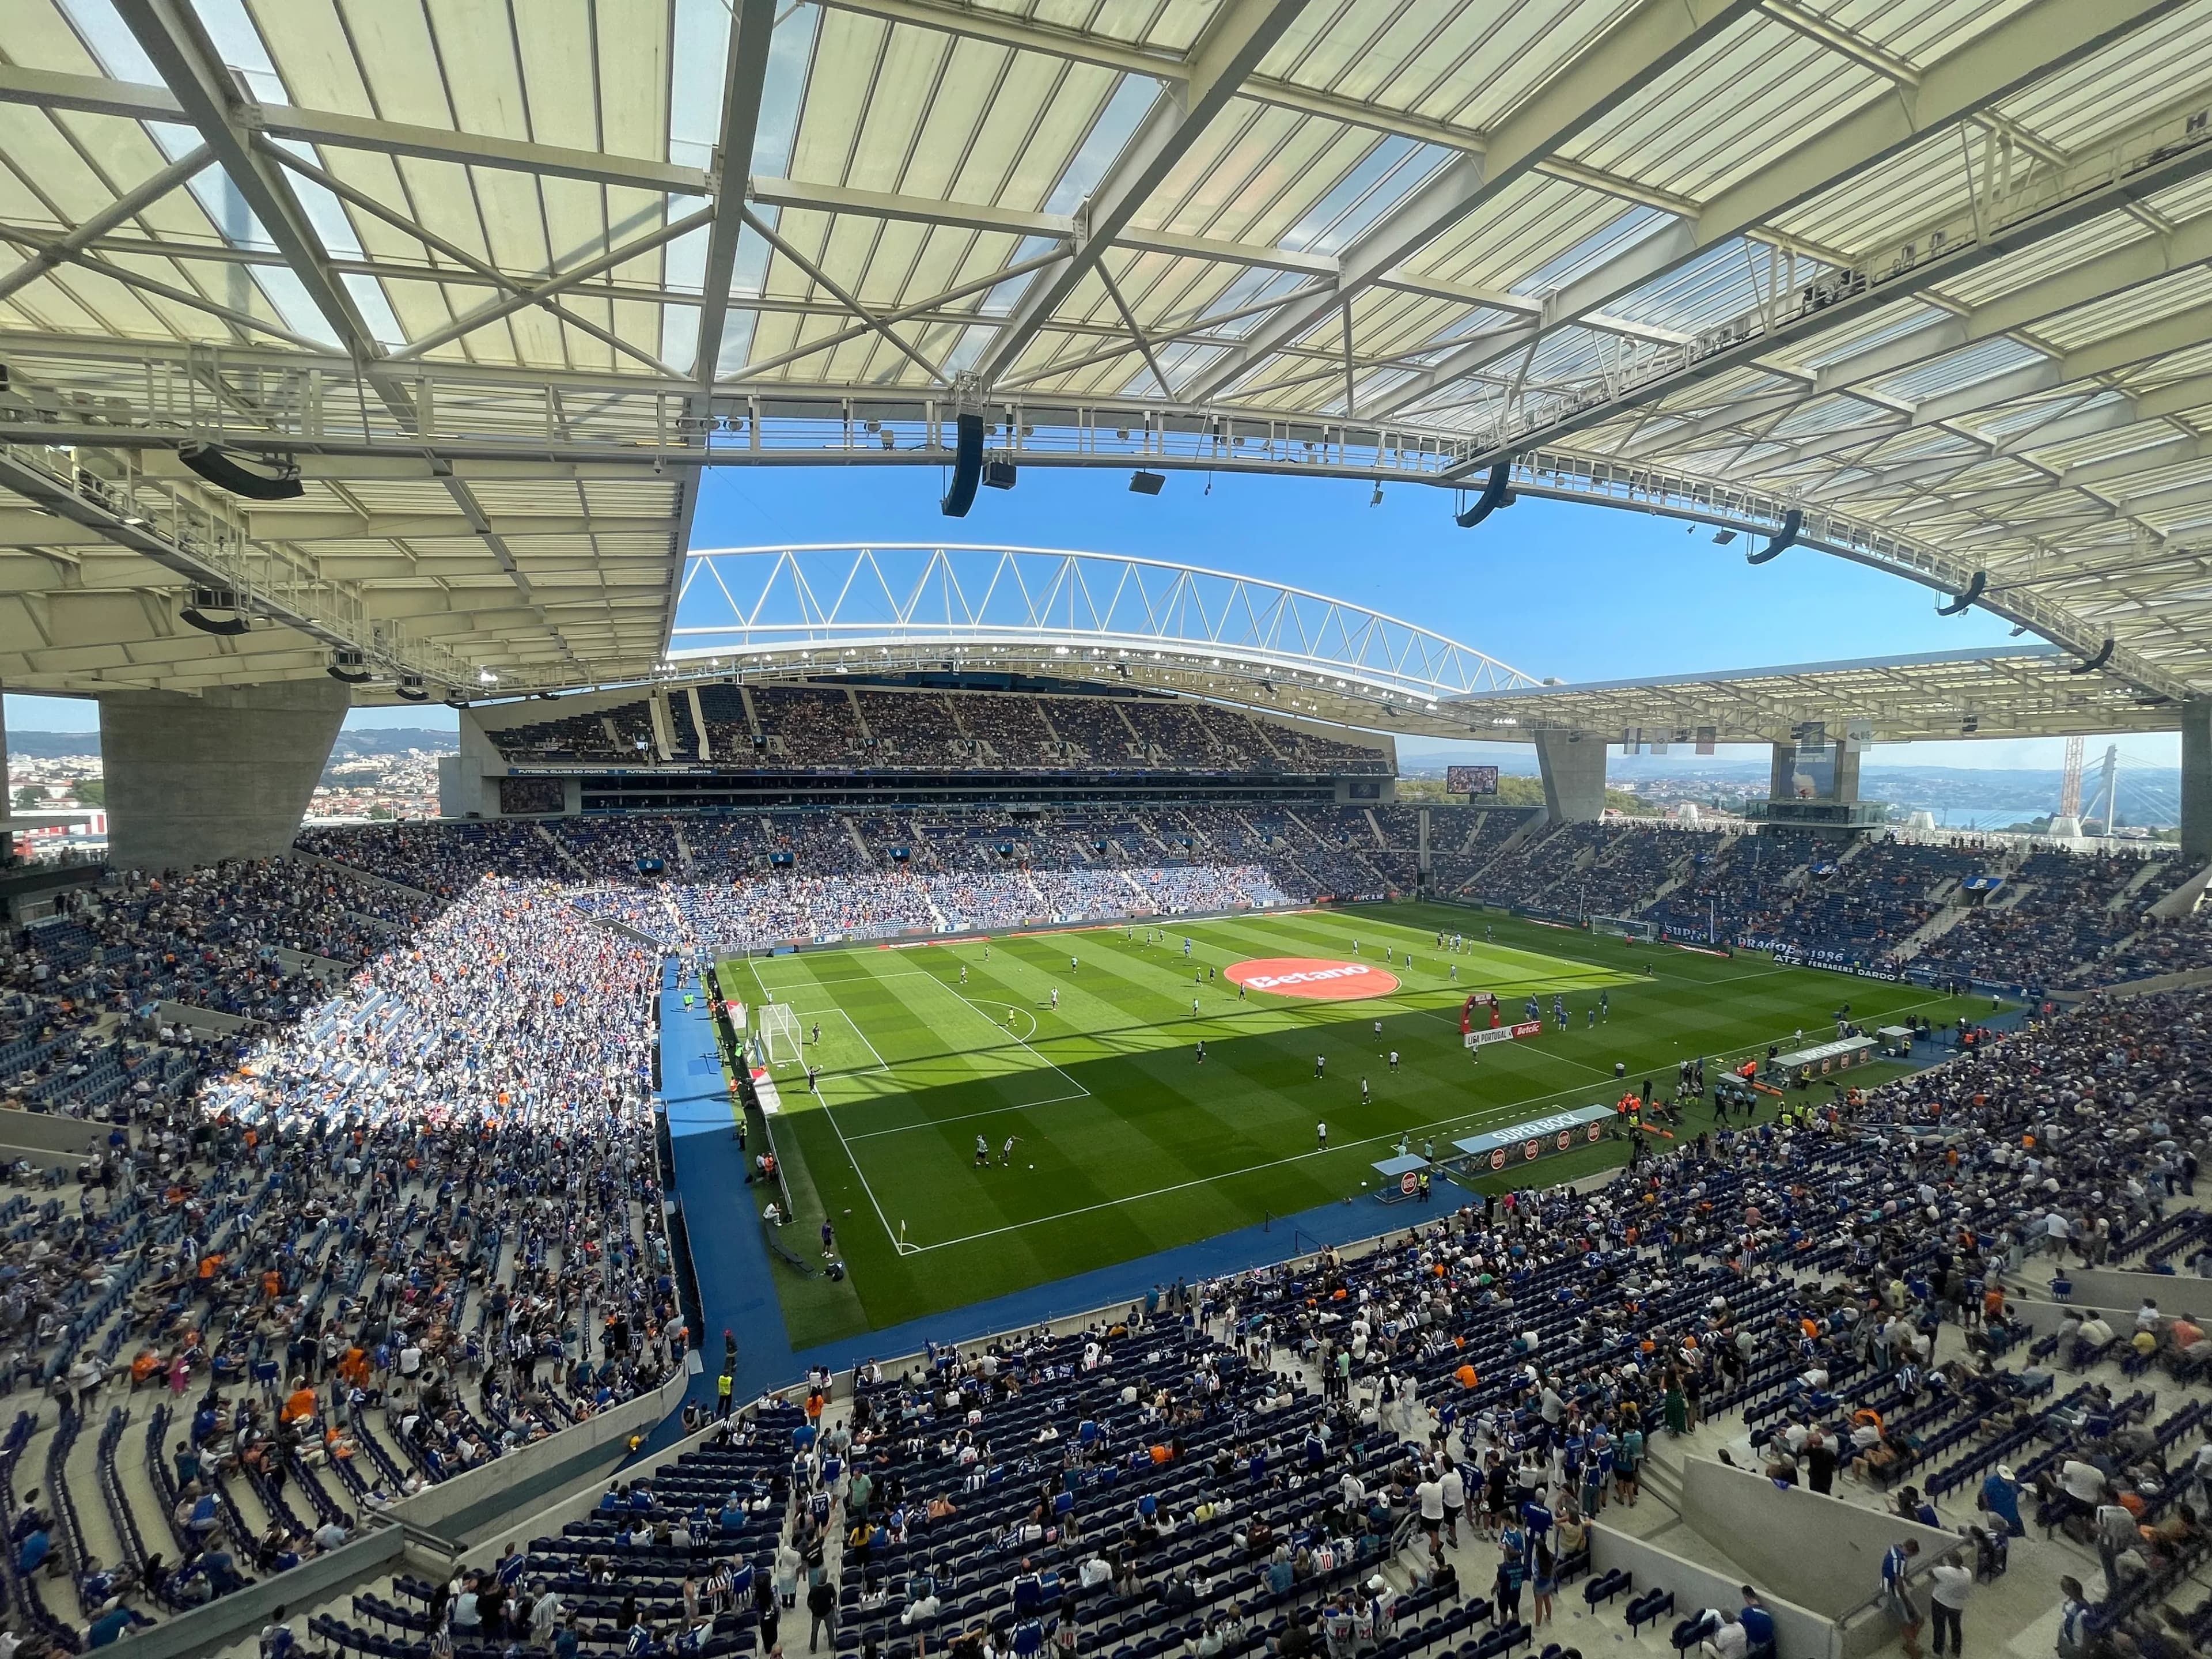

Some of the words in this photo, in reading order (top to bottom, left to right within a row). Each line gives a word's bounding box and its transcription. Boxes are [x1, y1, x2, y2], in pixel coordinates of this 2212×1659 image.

[1103, 911, 1127, 919] ONLINE
[977, 922, 992, 930] BUY
[993, 919, 1020, 928] ONLINE
[869, 929, 899, 939] ONLINE
[720, 945, 740, 953] BUY
[741, 940, 775, 951] ONLINE
[1773, 954, 1801, 965] ATZ
[1244, 964, 1370, 988] Betano
[1858, 969, 1895, 981] DARDO
[1517, 1024, 1540, 1035] Betclic
[1468, 1035, 1479, 1046] LIGA
[1481, 1030, 1506, 1043] PORTUGAL
[1491, 1124, 1546, 1142] SUPER
[1539, 1113, 1585, 1131] BOCK
[815, 1502, 826, 1513] 16
[1320, 1554, 1332, 1569] 10
